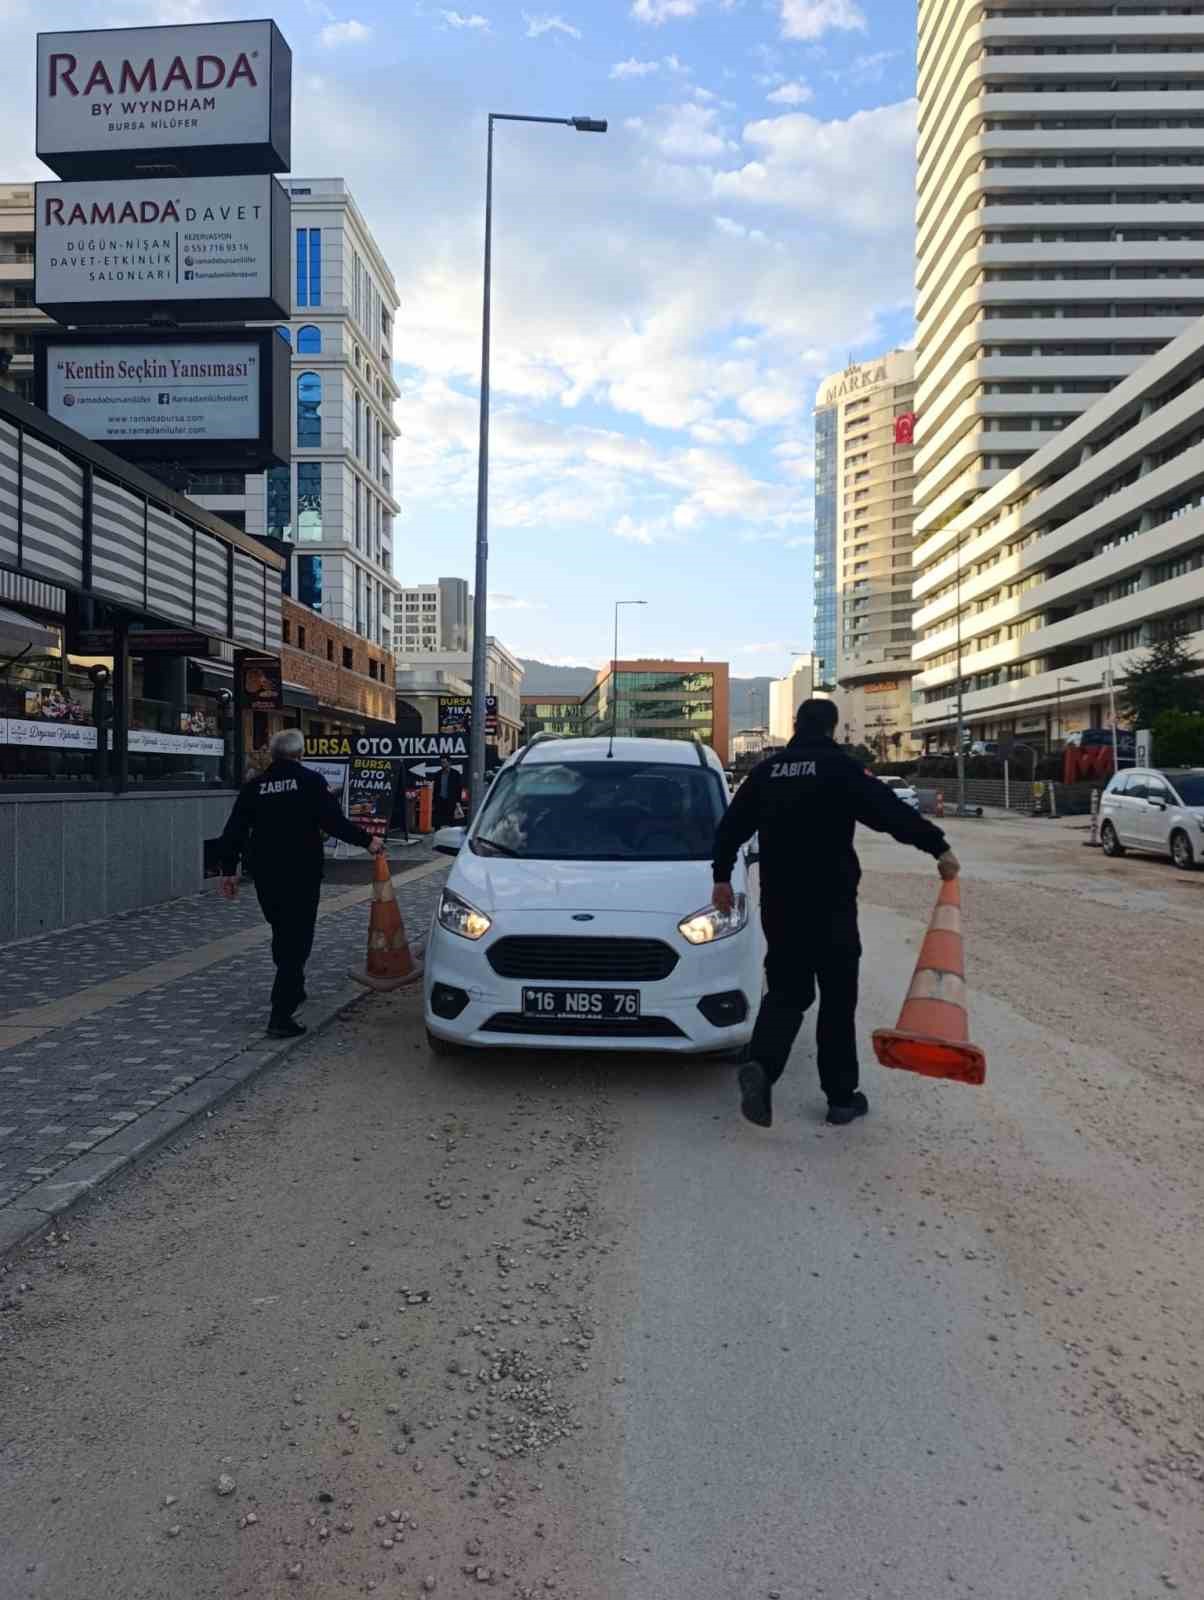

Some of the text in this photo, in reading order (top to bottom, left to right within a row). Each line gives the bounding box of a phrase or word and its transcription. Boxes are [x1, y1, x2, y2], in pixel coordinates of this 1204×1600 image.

[48, 52, 258, 97] RAMADA
[91, 97, 216, 116] BY WYNDHAM
[108, 118, 198, 131] BURSA NİLÜFER
[44, 198, 262, 226] RAMADA DAVET
[67, 238, 171, 252] DÜĞÜN-NİŞAN
[50, 255, 171, 267] DAVET-ETKİNLİK
[89, 271, 171, 281] SALONLARI
[118, 359, 168, 383] Seçkin
[303, 737, 466, 755] URSA OTO YIKAMA
[354, 759, 392, 769] BURSA
[771, 761, 816, 778] ZABITA
[361, 769, 385, 779] OTO
[259, 779, 298, 794] ZABITA
[535, 992, 637, 1013] 16 NBS 76
